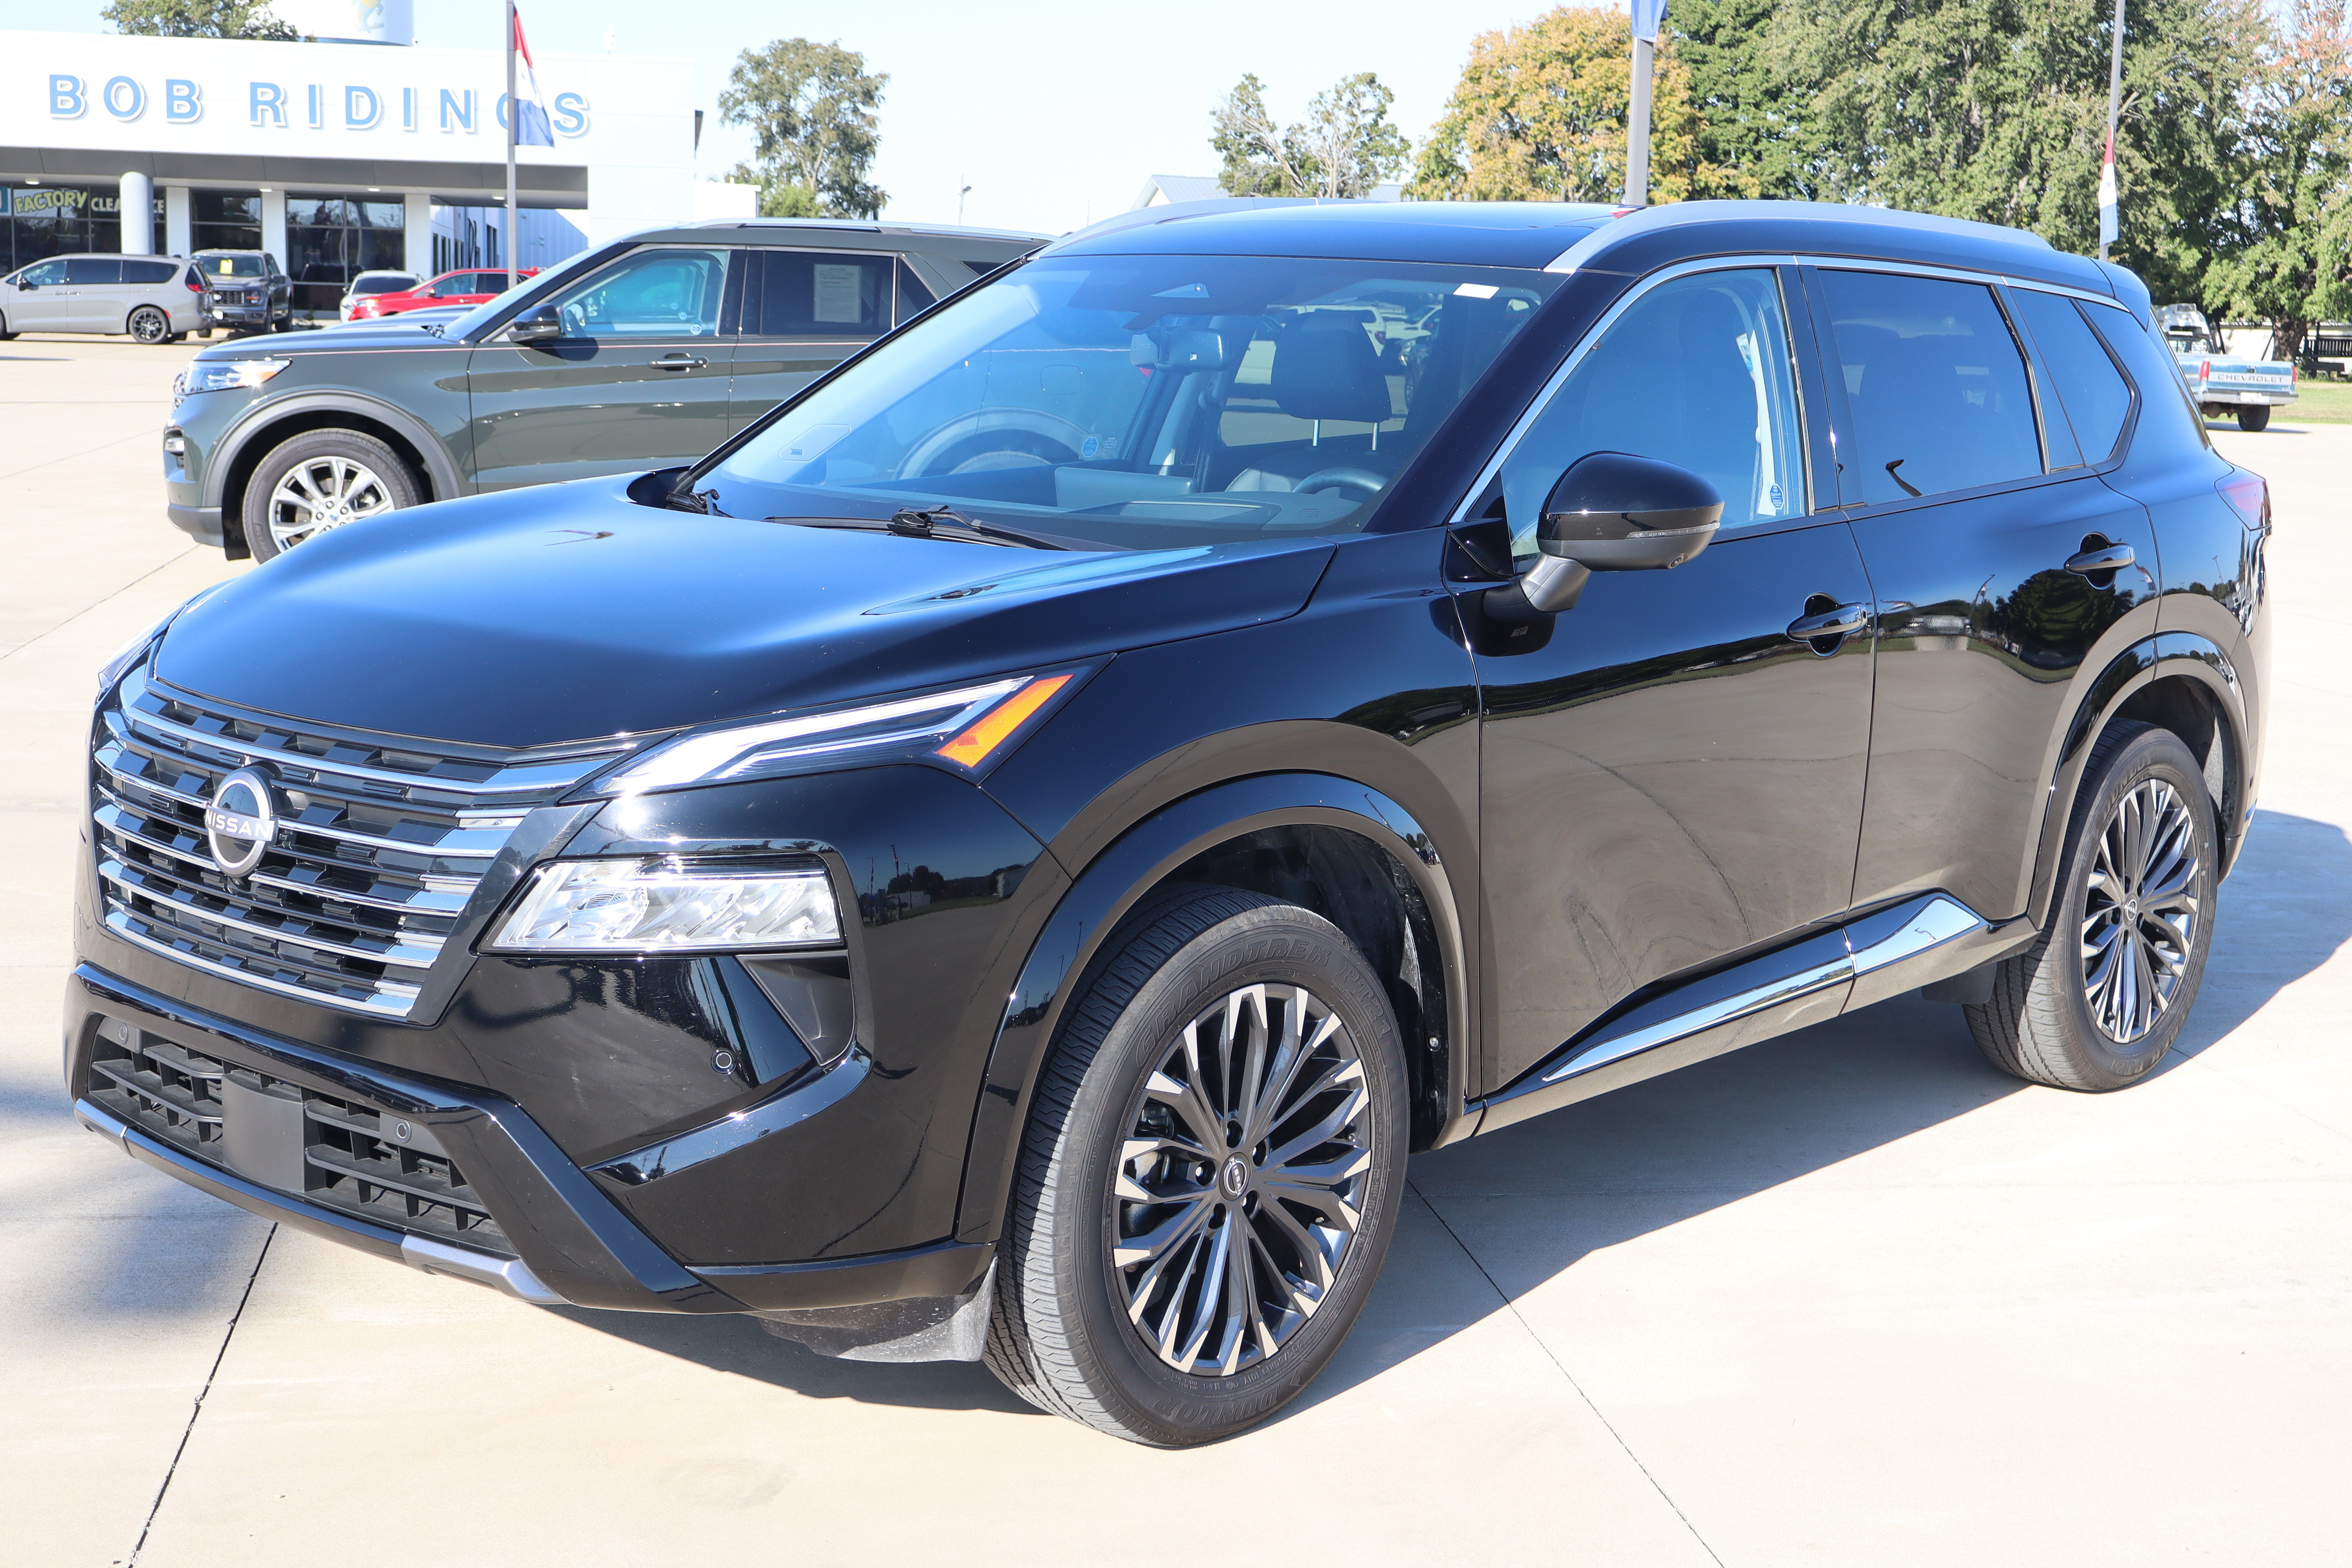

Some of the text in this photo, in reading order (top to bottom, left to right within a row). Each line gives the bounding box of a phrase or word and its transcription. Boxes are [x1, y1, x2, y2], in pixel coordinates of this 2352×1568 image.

[49, 74, 203, 122] BOB
[14, 190, 87, 214] FACTORY
[2218, 374, 2283, 383] CHEVROLET
[205, 808, 271, 837] NISSAN
[1136, 938, 1332, 1067] GRANDTREK
[1336, 962, 1392, 1039] PT21
[1230, 1158, 1241, 1196] NISSAN
[1154, 1383, 1281, 1425] DUNLOP
